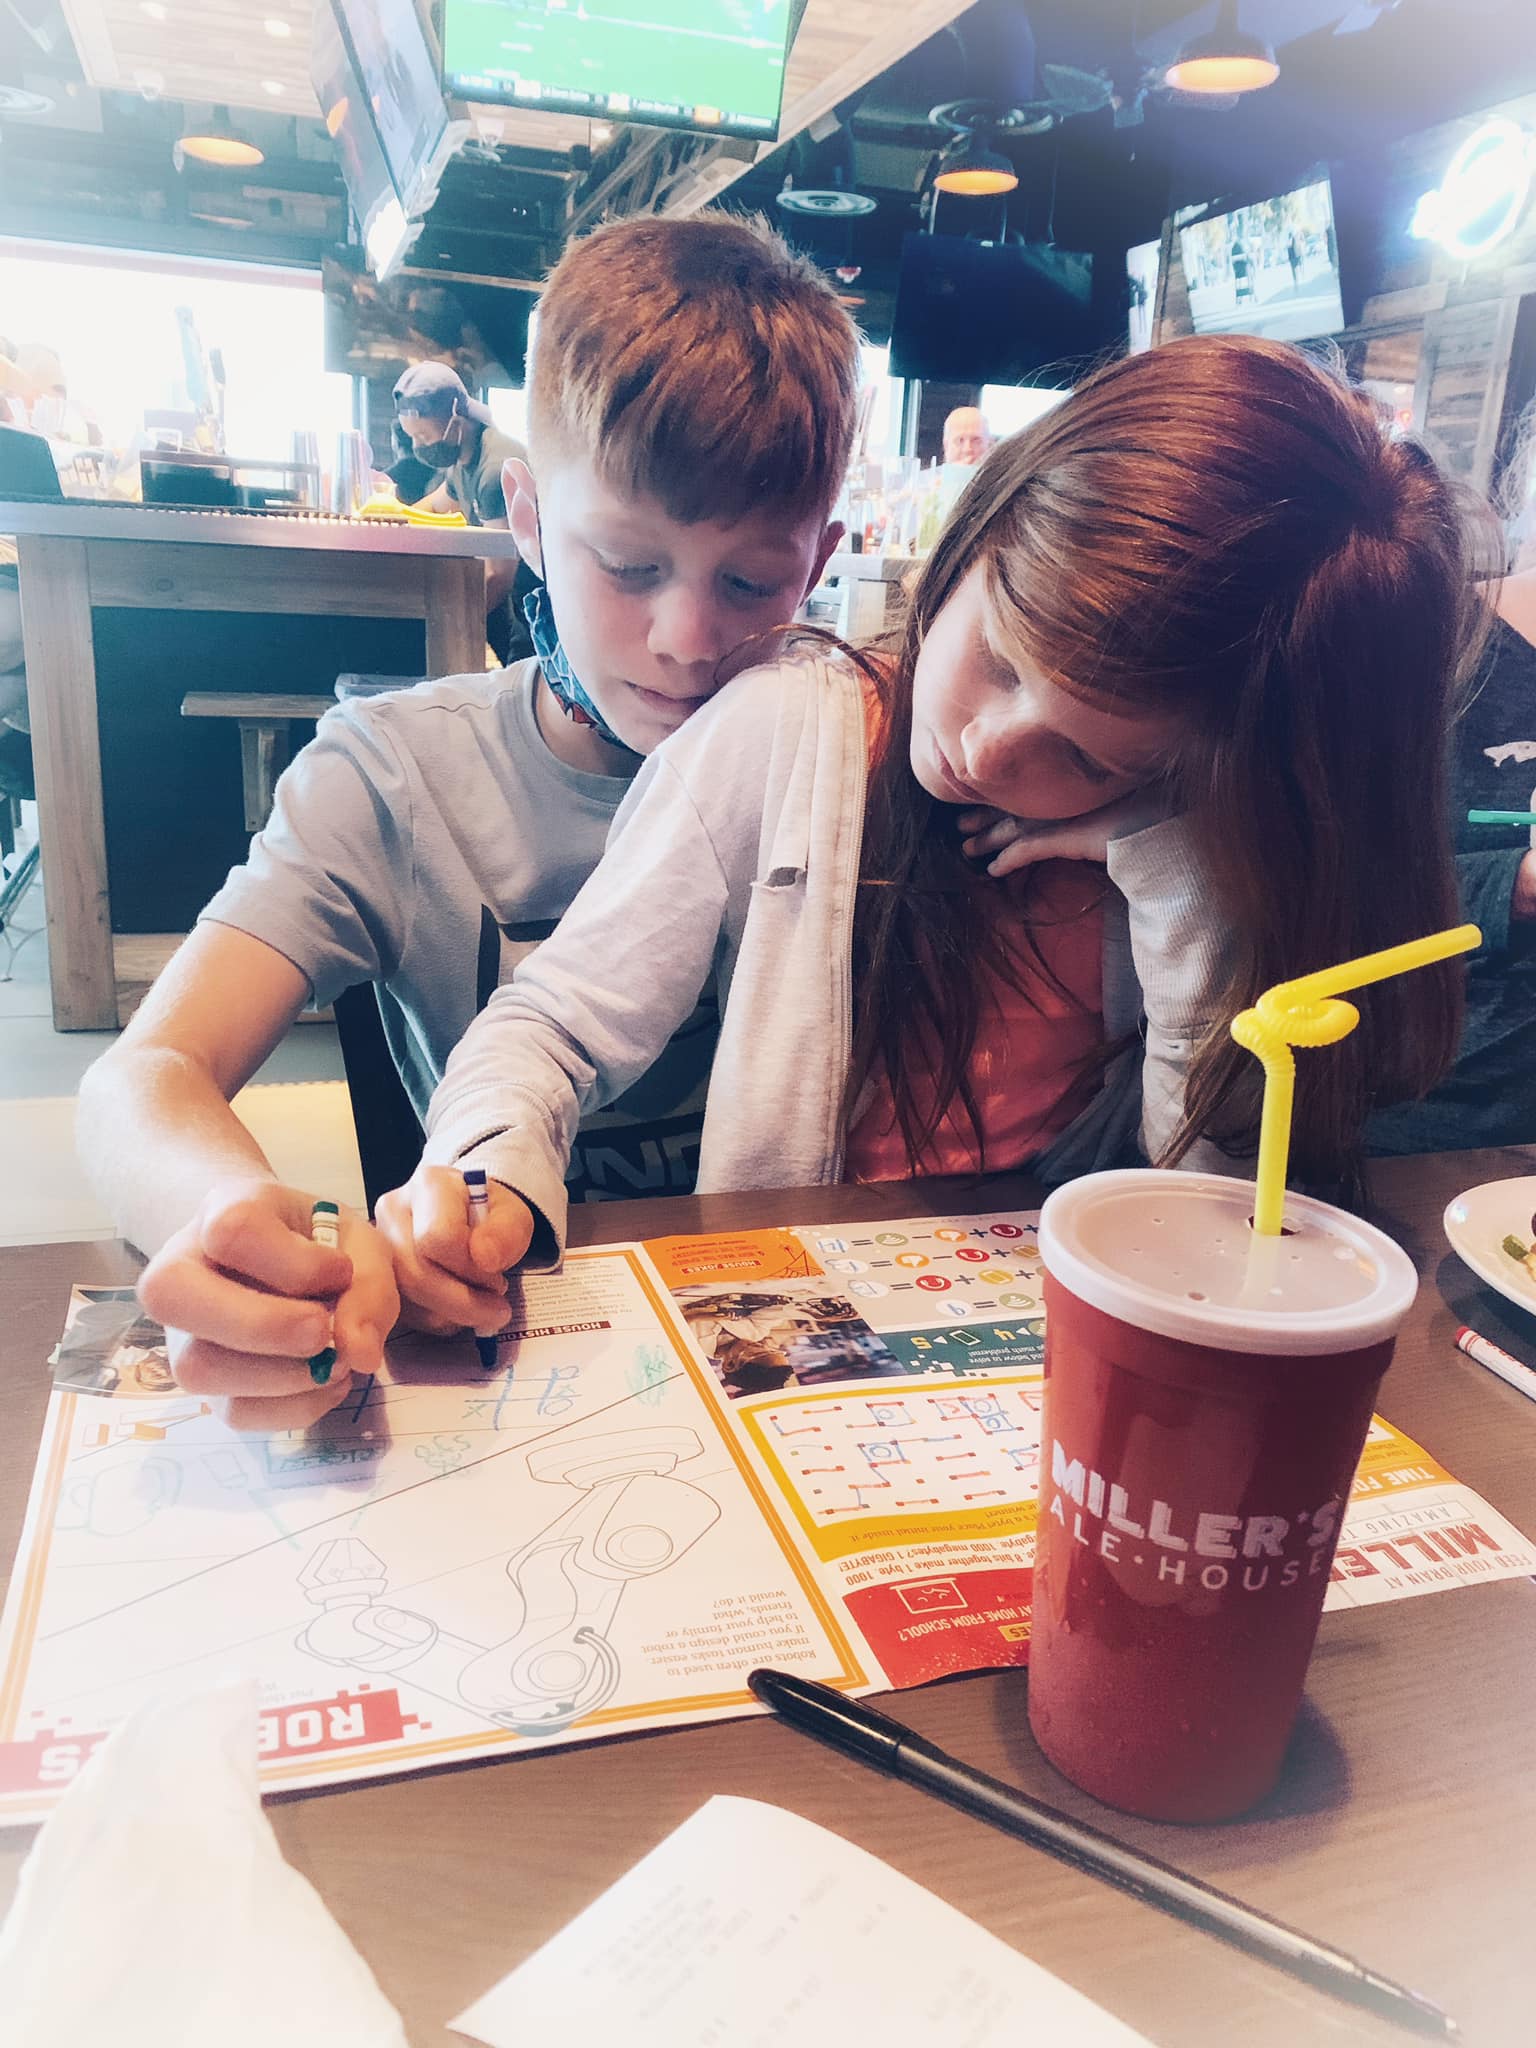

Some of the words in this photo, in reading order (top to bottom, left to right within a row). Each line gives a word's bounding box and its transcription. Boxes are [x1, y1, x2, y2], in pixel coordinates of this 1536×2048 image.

[554, 1322, 601, 1333] HOUSE
[497, 1328, 550, 1342] HISTOR
[993, 1328, 1016, 1341] 4
[910, 1336, 933, 1350] 5
[1381, 1466, 1435, 1486] TIME
[1052, 1439, 1342, 1559] MILLER'S
[1365, 1506, 1450, 1534] AMAZING
[895, 1527, 929, 1536] initial
[932, 1524, 955, 1533] your
[958, 1523, 985, 1531] Place
[862, 1529, 894, 1539] inside
[970, 1542, 994, 1552] 1000
[1050, 1494, 1122, 1563] ALE
[1158, 1550, 1324, 1590] HOUSE
[897, 1551, 904, 1559] 1
[907, 1542, 968, 1558] megabytes?
[838, 1552, 894, 1572] GIGABYTE!
[914, 1558, 945, 1572] make
[947, 1551, 992, 1566] together
[993, 1553, 1012, 1564] bits
[1493, 1553, 1533, 1568] FEED
[906, 1564, 912, 1573] 1
[1455, 1558, 1493, 1574] YOUR
[845, 1571, 873, 1586] 1000
[1405, 1566, 1454, 1585] BRAIN
[1382, 1577, 1403, 1590] AT
[737, 1596, 745, 1604] it
[749, 1589, 785, 1602] would
[713, 1598, 734, 1609] do?
[749, 1600, 793, 1613] friends,
[1018, 1604, 1033, 1616] AY
[712, 1609, 744, 1620] what
[757, 1614, 783, 1626] help
[785, 1612, 798, 1621] to
[950, 1612, 985, 1628] FROM
[983, 1607, 1018, 1622] HOME
[682, 1624, 722, 1638] family
[726, 1619, 753, 1631] your
[769, 1624, 793, 1634] you
[794, 1624, 805, 1634] If
[897, 1617, 951, 1642] SCHOOL?
[665, 1630, 679, 1638] or
[689, 1634, 730, 1647] design
[733, 1630, 766, 1642] could
[640, 1644, 674, 1654] robot
[775, 1637, 810, 1648] make
[690, 1649, 725, 1661] tasks
[727, 1643, 773, 1656] human
[774, 1649, 817, 1662] Robots
[716, 1659, 748, 1672] often
[752, 1655, 773, 1665] are
[667, 1668, 680, 1677] to
[684, 1664, 713, 1677] used
